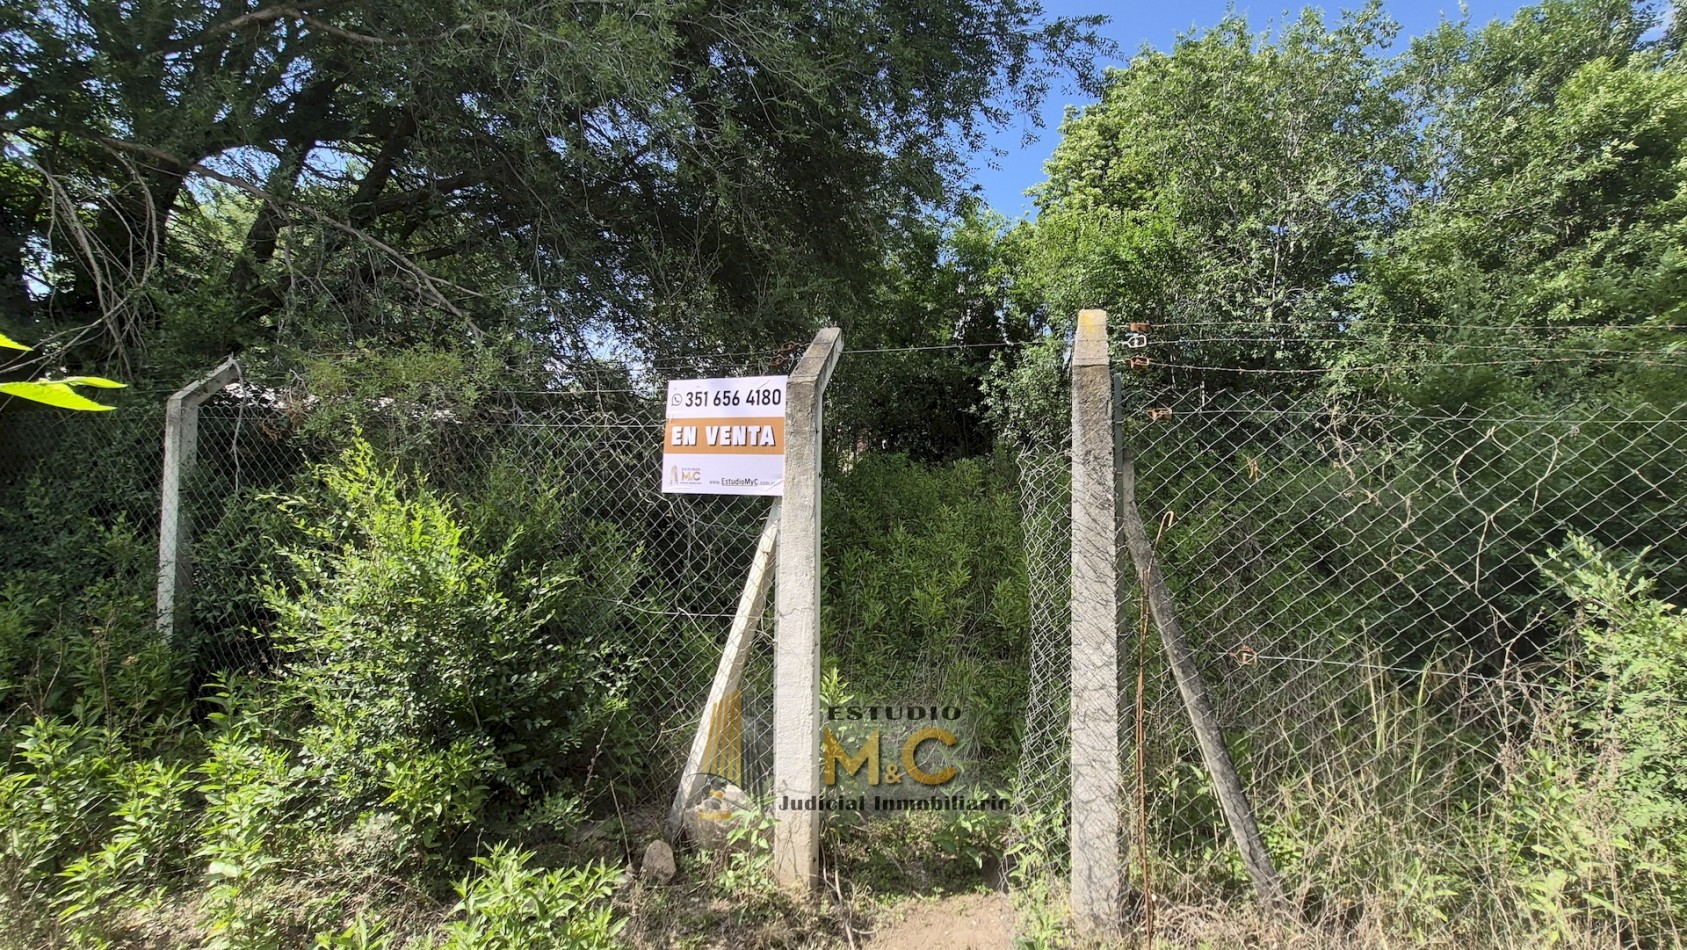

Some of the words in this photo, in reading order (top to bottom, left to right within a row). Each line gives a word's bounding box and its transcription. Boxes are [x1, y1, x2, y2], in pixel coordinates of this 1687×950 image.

[685, 391, 708, 407] 351
[713, 390, 740, 406] 656
[746, 389, 781, 405] 4180
[672, 426, 697, 446] EN
[705, 426, 776, 446] VENTA
